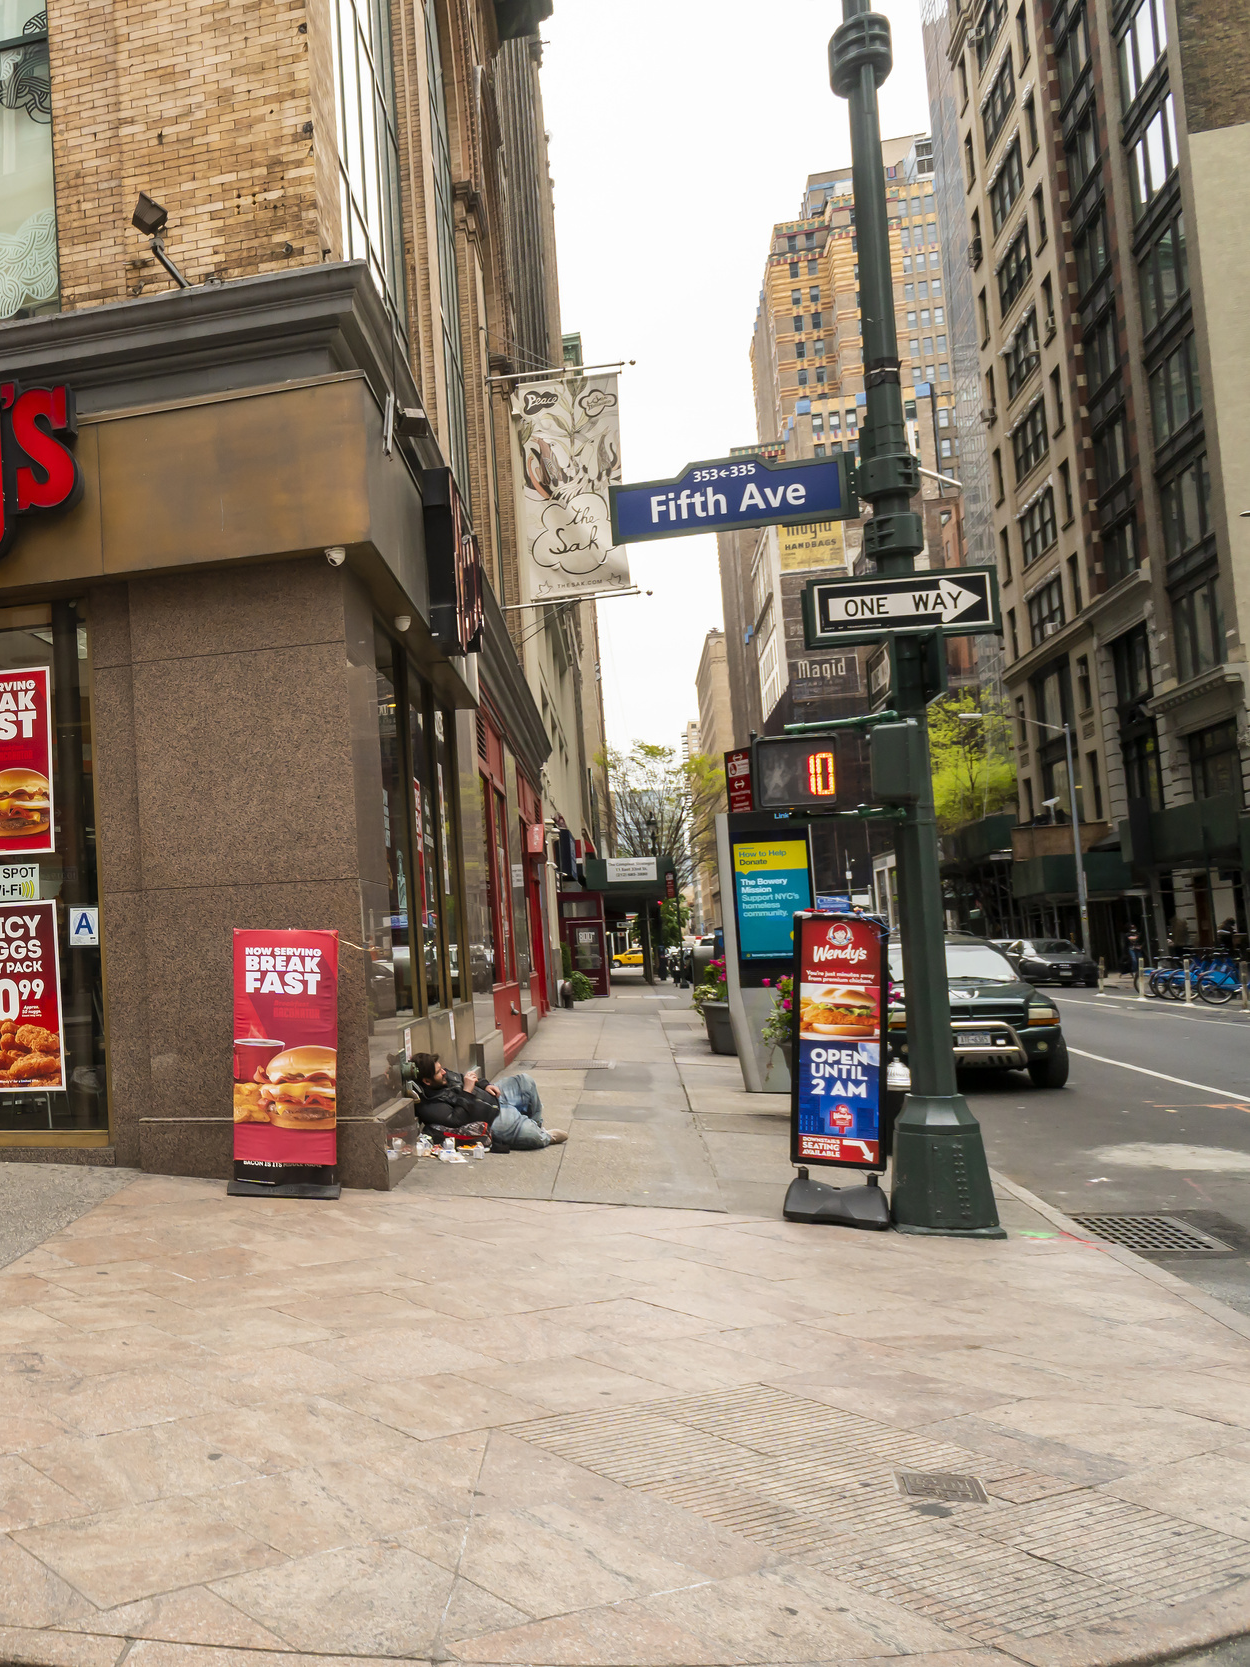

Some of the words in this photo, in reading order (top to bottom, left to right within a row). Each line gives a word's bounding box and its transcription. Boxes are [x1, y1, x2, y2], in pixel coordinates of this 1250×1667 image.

[527, 394, 558, 411] Peace
[693, 468, 720, 483] 353
[729, 463, 756, 477] 335
[650, 490, 728, 524] Fifth
[738, 480, 807, 513] Ave
[549, 525, 599, 555] Sak
[785, 539, 836, 551] HANDBAGS
[557, 579, 603, 589] THESAK.COM
[844, 596, 889, 617] ONE
[912, 590, 963, 612] WAY
[798, 657, 846, 681] Magid
[808, 752, 835, 795] 10
[774, 812, 789, 820] Link
[768, 849, 787, 858] Help
[739, 858, 767, 866] Donate
[2, 867, 36, 879] SPOT
[740, 878, 756, 886] The
[757, 877, 787, 887] Bowery
[741, 886, 772, 894] Mission
[741, 894, 774, 903] Support
[775, 893, 800, 901] NYC's
[74, 912, 94, 935] A
[245, 947, 271, 956] NOW
[273, 947, 322, 957] SERVING
[813, 945, 867, 964] Wendy's
[6, 960, 43, 974] PACK
[245, 955, 321, 973] BREAK
[245, 972, 321, 995] FAST
[810, 1048, 868, 1065] OPEN
[811, 1064, 868, 1081] UNTIL
[811, 1078, 826, 1096] 2
[830, 1080, 867, 1098] AM
[802, 1135, 841, 1145] DOWNSTAIRS
[802, 1142, 840, 1152] SEATING
[802, 1149, 841, 1158] AVAILABLE
